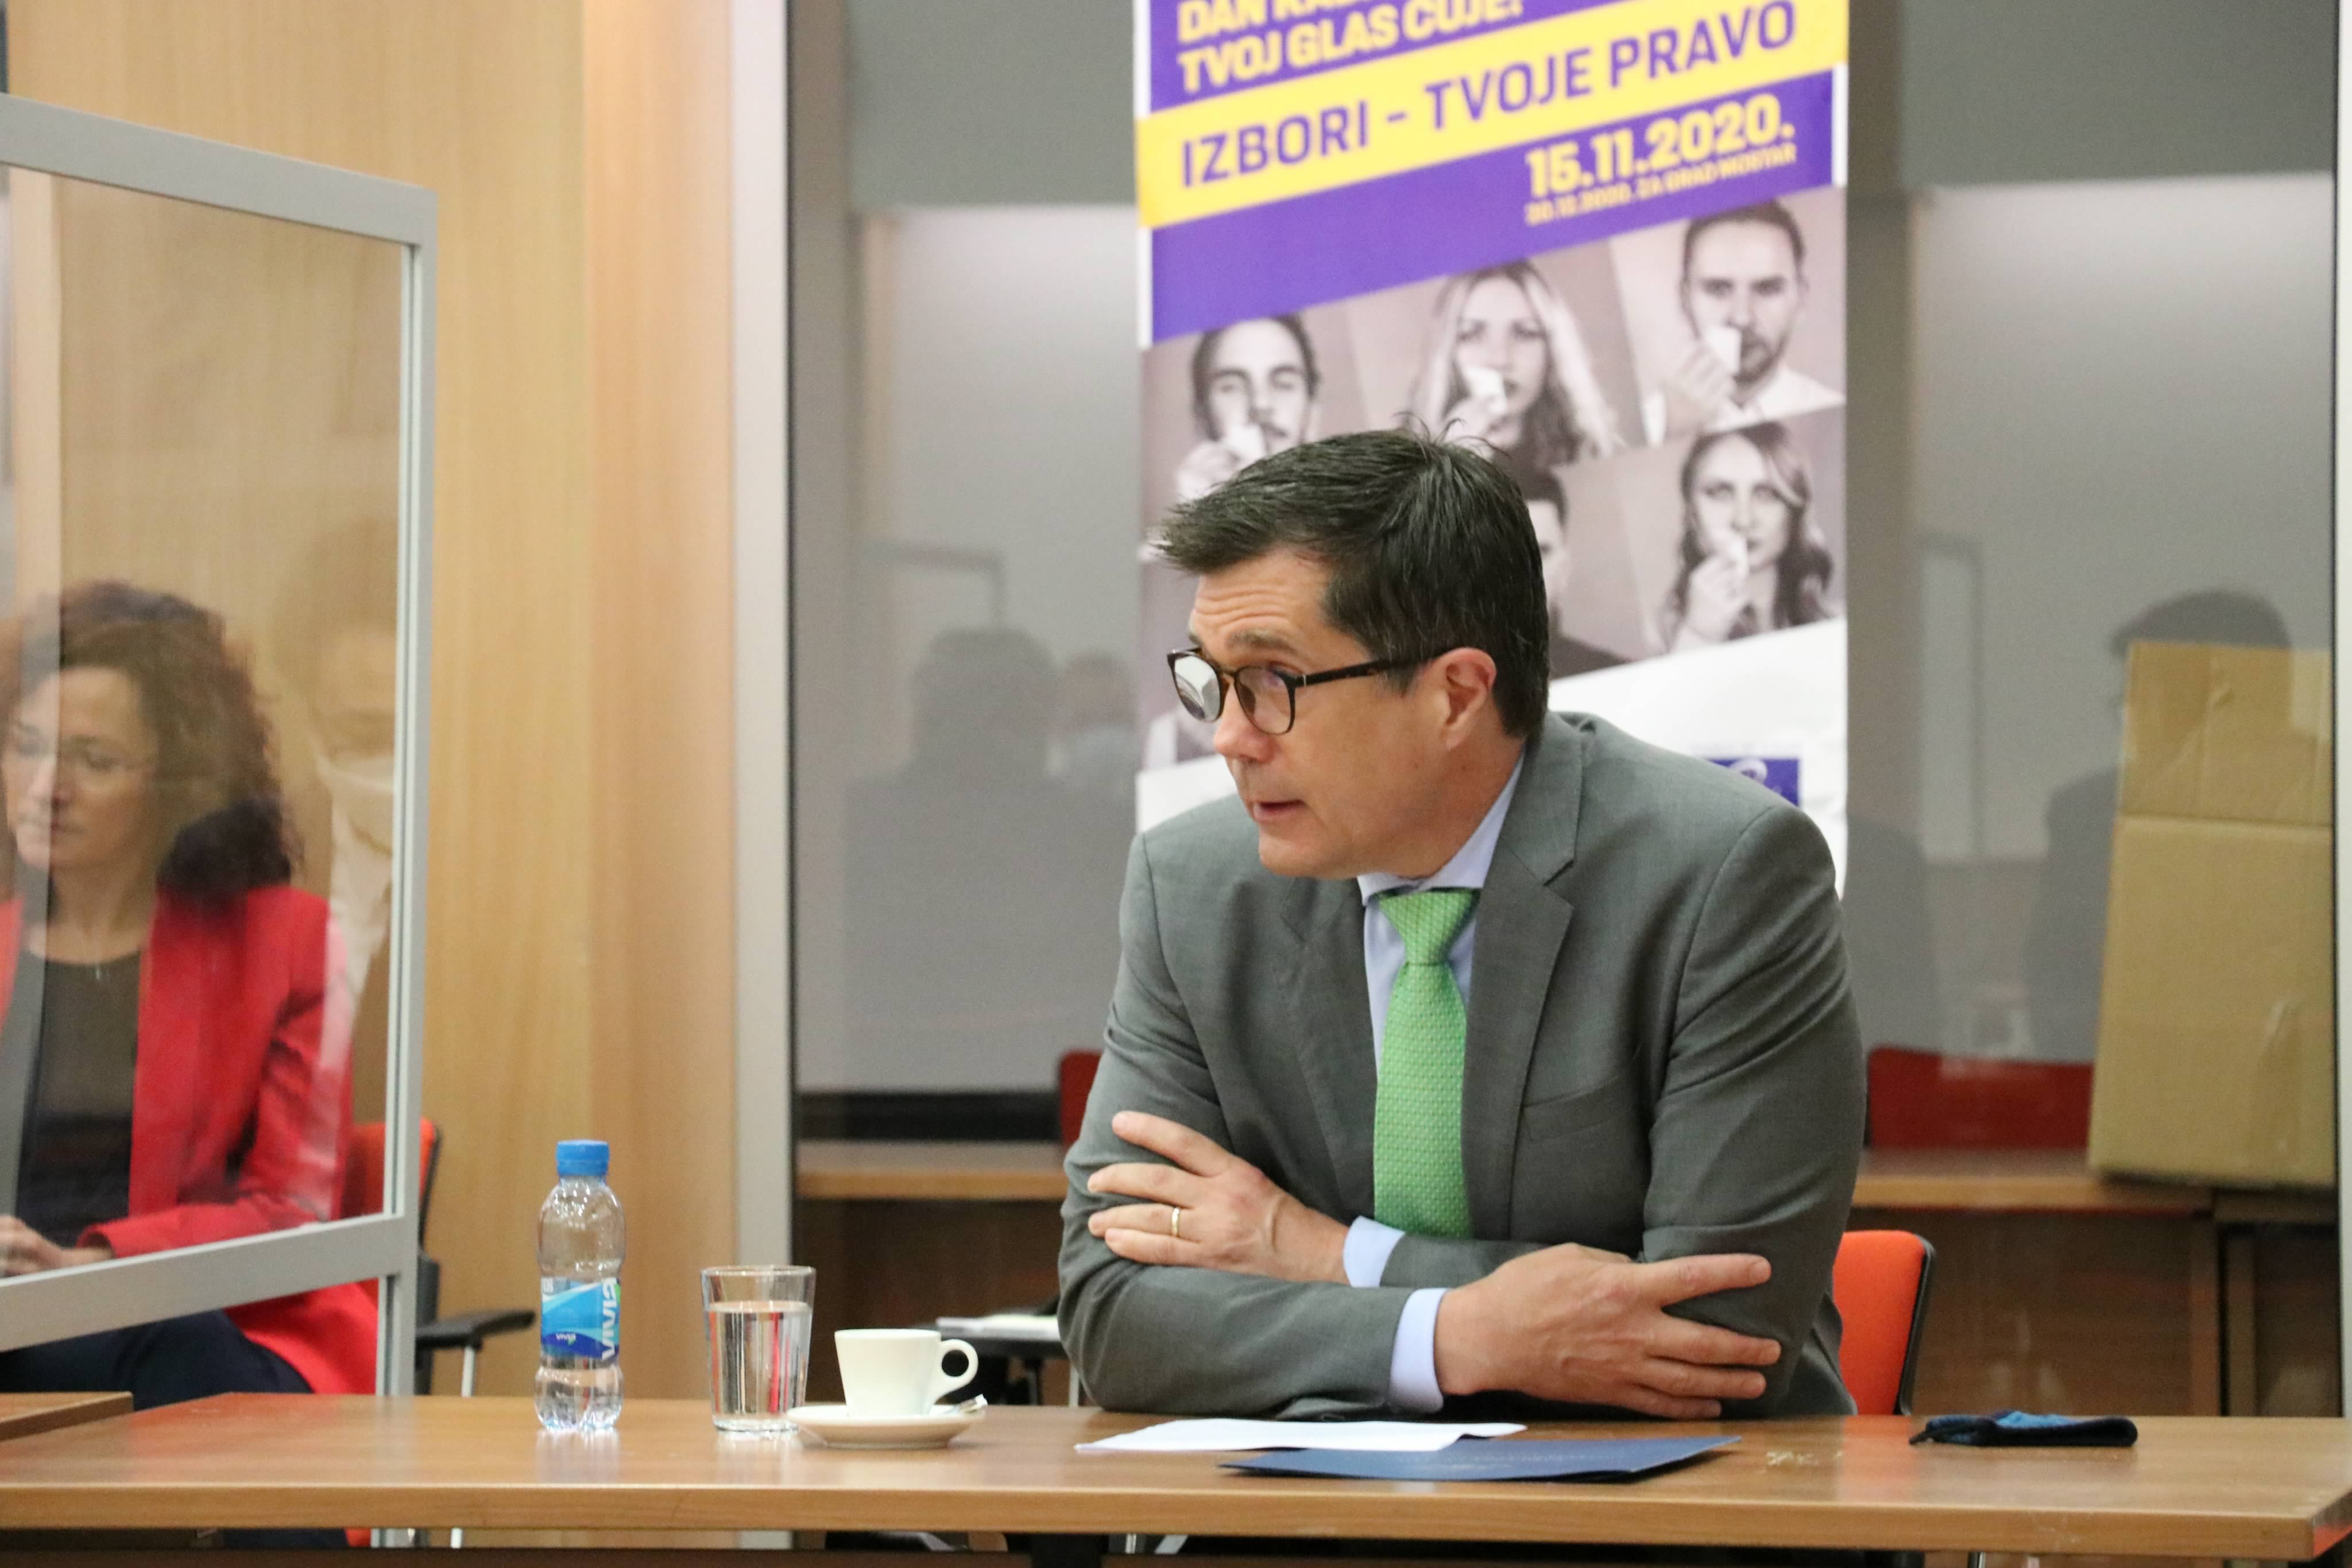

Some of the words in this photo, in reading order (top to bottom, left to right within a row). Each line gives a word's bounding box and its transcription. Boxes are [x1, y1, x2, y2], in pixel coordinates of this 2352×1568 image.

[1178, 0, 1266, 42] DAN
[1178, 31, 1282, 92] TVOJ
[1287, 5, 1399, 67] GLAS
[1183, 100, 1367, 187] IZBORI
[1387, 111, 1407, 123] -
[1425, 48, 1592, 130] TVOJE
[1610, 0, 1796, 88] PRAVO
[1525, 94, 1796, 198] 15.11.2020.
